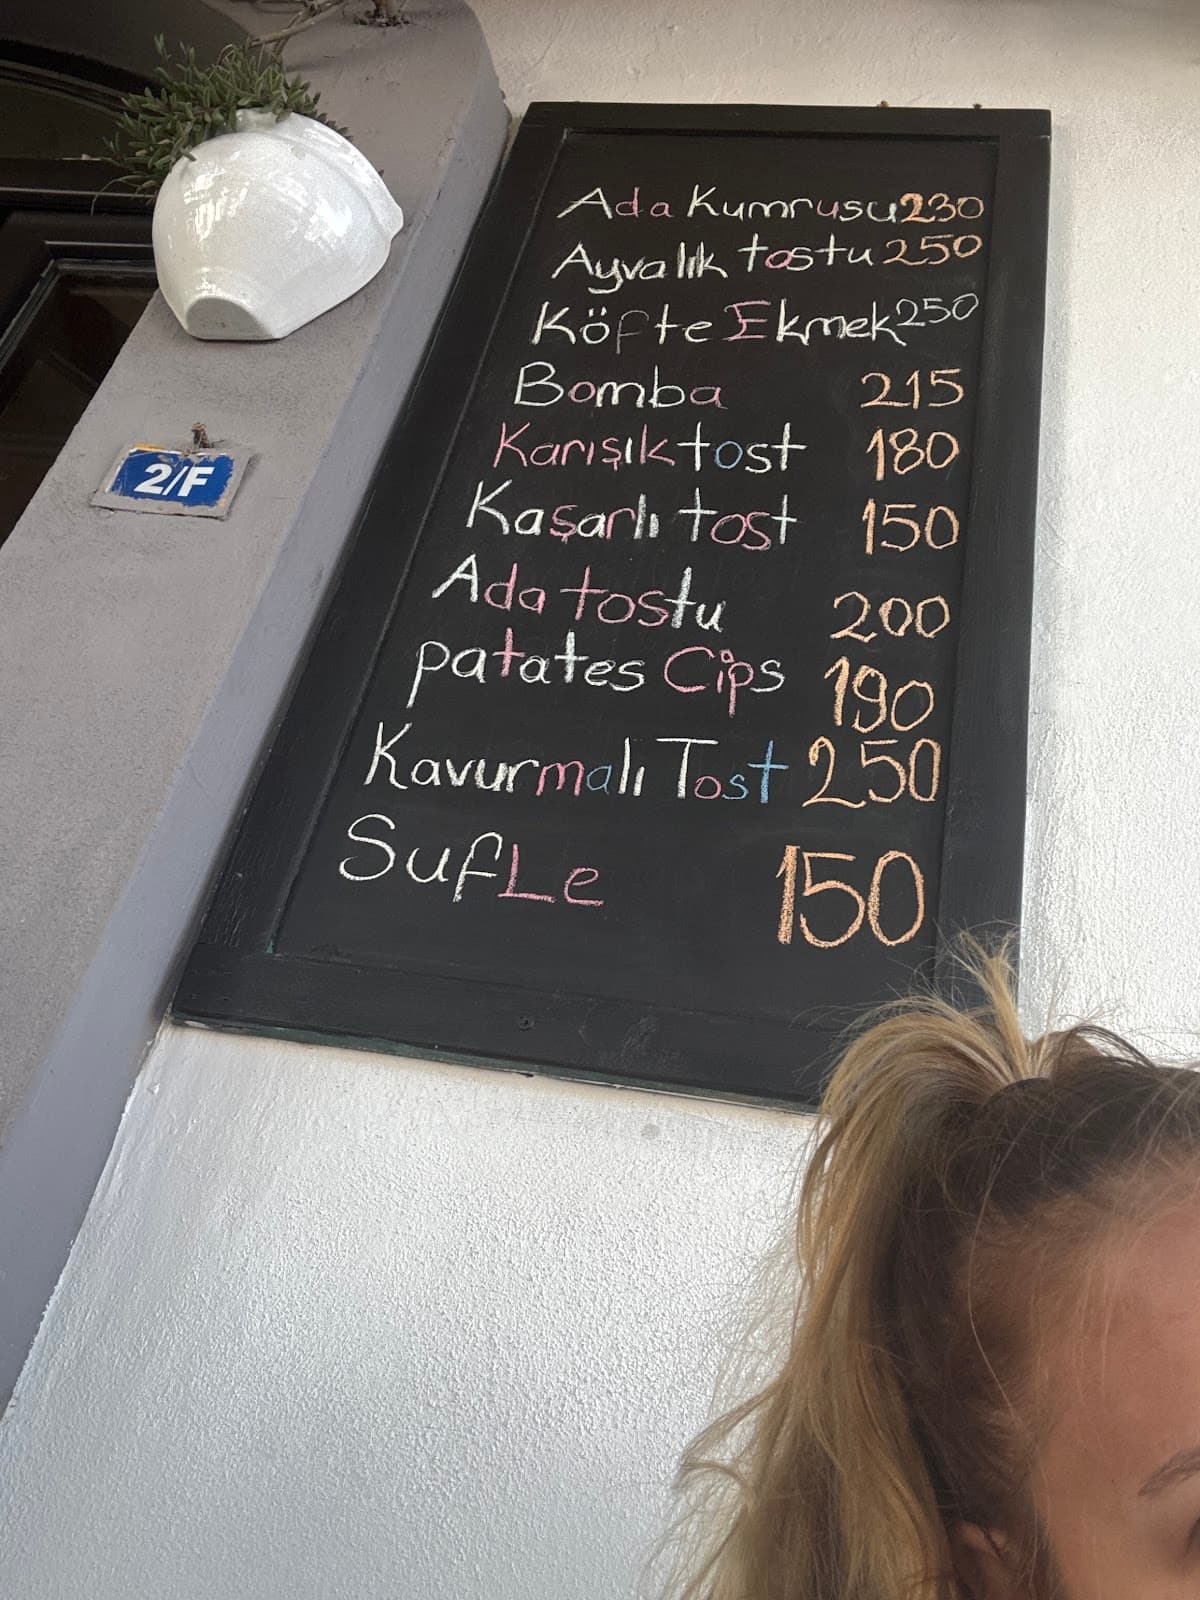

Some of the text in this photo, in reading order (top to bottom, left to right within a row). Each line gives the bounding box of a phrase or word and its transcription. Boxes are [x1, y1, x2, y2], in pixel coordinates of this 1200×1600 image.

[557, 184, 985, 223] Ada Kumrusu 230
[737, 233, 873, 272] tostu
[883, 234, 983, 265] 250
[531, 293, 979, 354] Köfte Ekmek 250
[514, 361, 964, 409] Bomba 215
[133, 463, 215, 497] 2/F
[493, 422, 960, 481] Karışık tost 180
[466, 480, 959, 554] Kaşarlı tost 150
[432, 554, 950, 643] Ada tostu 200
[407, 628, 934, 733] patates Cips 190
[364, 721, 941, 808] Kavurmalı Tost 250
[776, 845, 924, 948] 150
